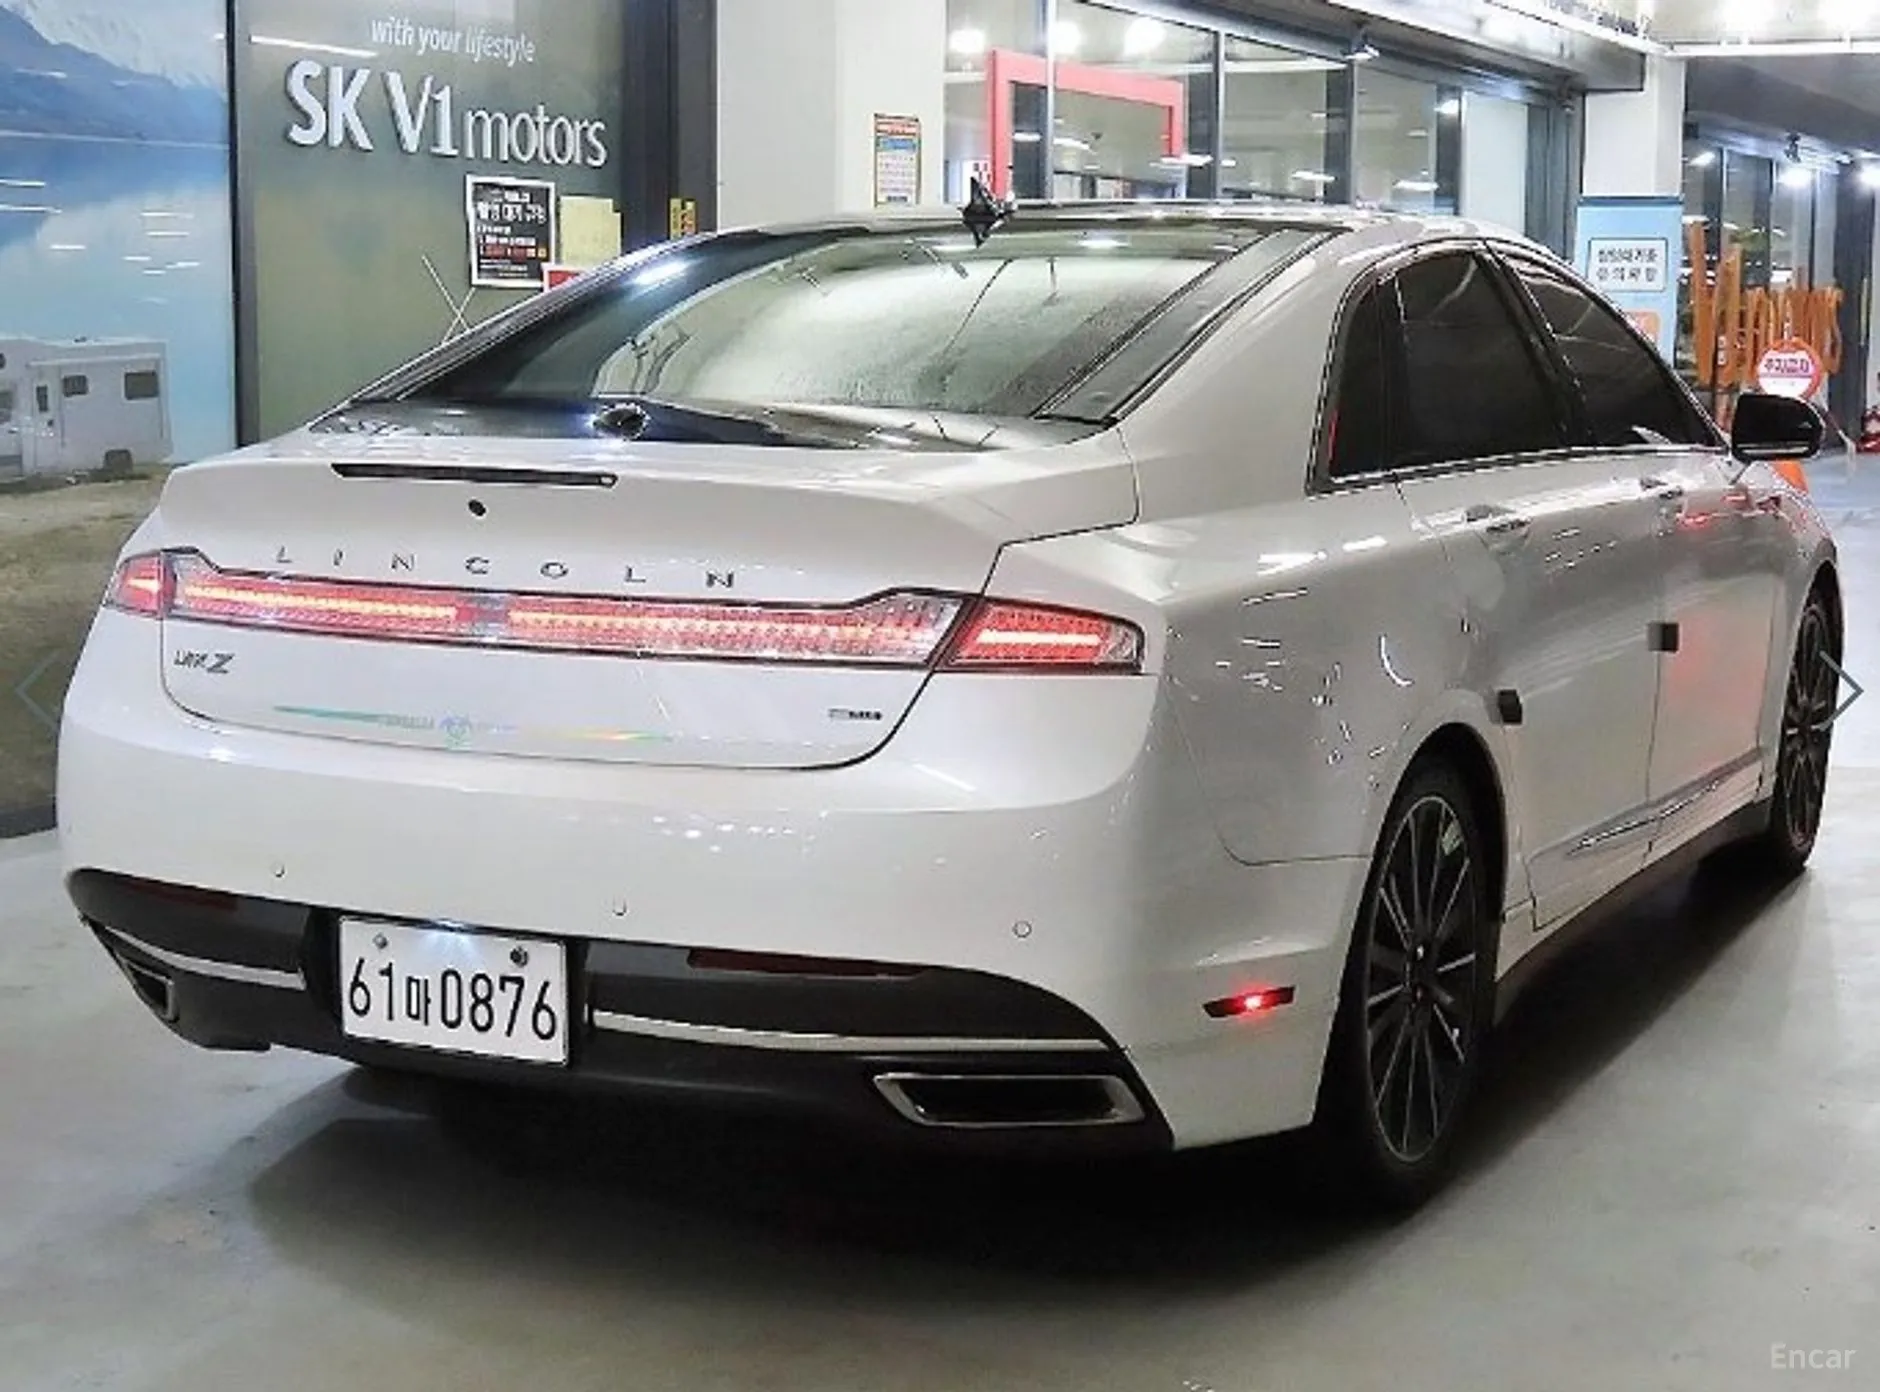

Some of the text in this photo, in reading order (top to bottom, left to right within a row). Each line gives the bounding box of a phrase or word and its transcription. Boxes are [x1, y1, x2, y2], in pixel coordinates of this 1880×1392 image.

[371, 16, 536, 68] with your lifestyle
[286, 60, 607, 168] SK V1 motors
[275, 545, 735, 590] LINCOLN
[349, 956, 558, 1041] 61마0876
